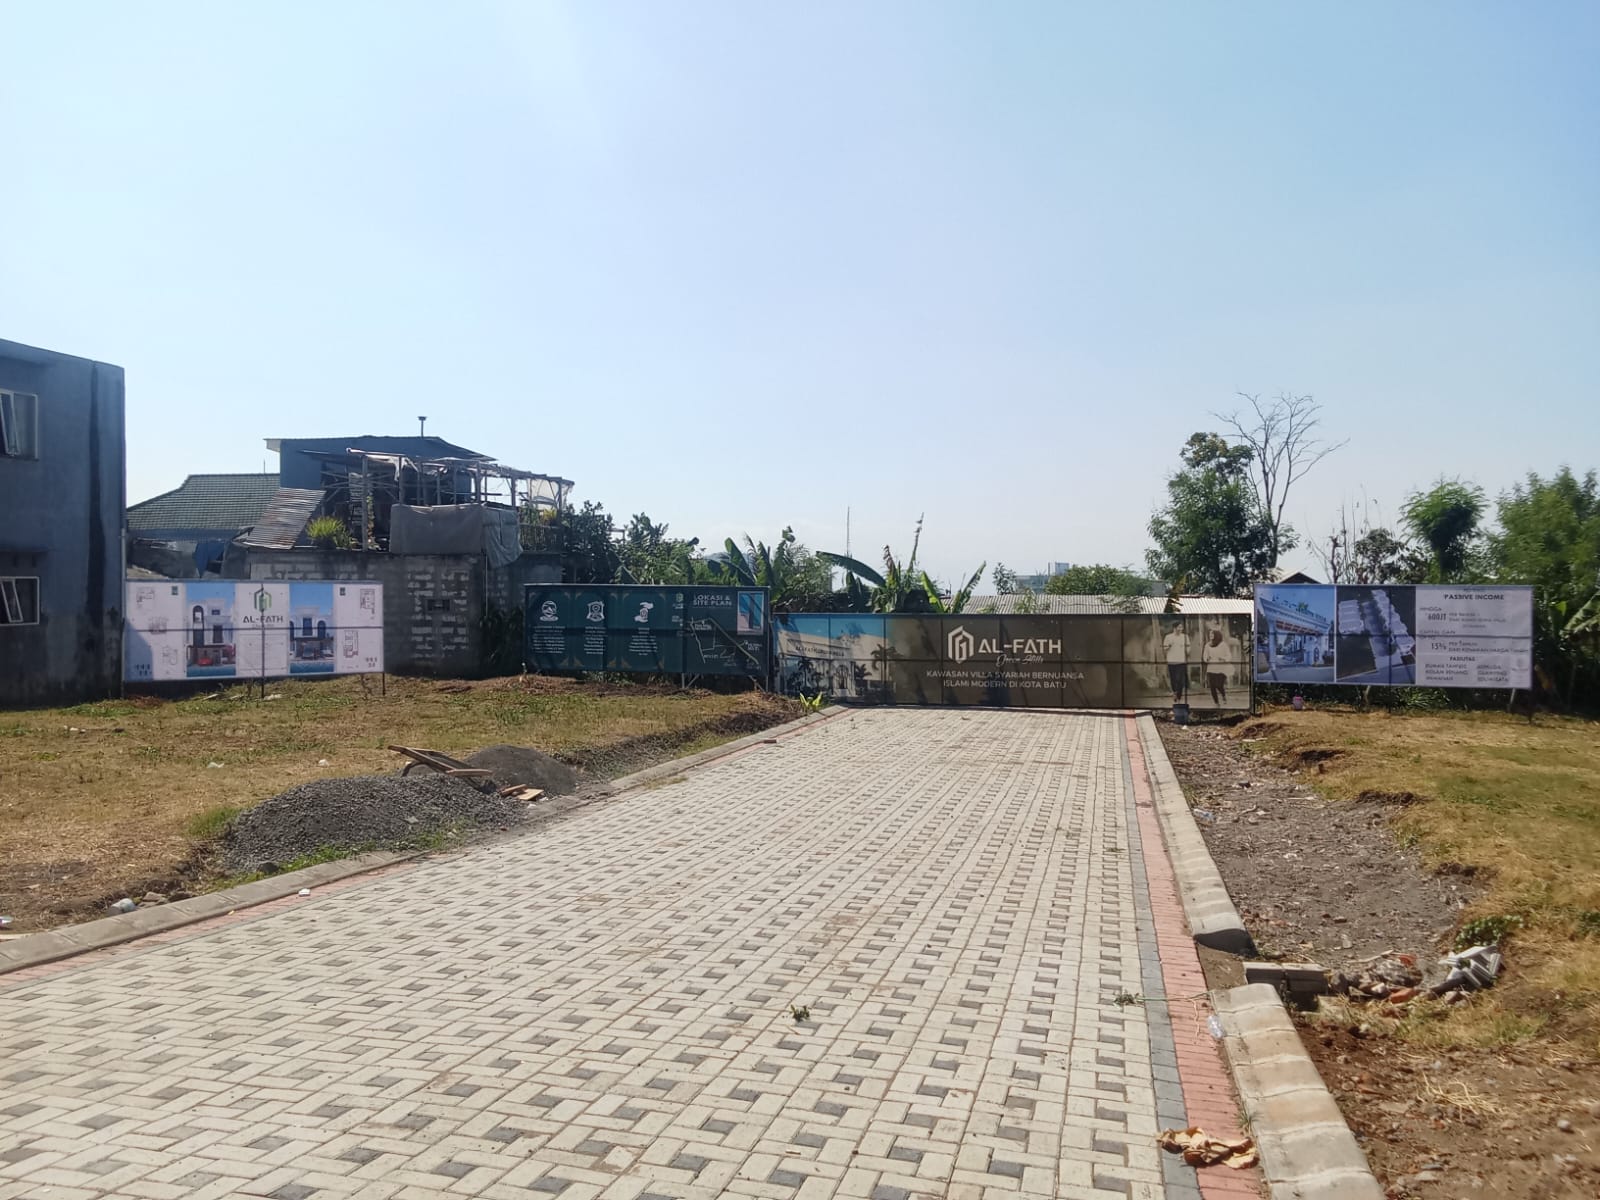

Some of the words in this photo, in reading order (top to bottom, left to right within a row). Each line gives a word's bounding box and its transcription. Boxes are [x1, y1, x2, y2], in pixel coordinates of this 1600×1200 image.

[978, 638, 1061, 654] AL-FATH
[926, 670, 968, 678] KAWASAN
[995, 671, 1030, 679] SYARIAH
[1032, 671, 1084, 679] BERNUANSA
